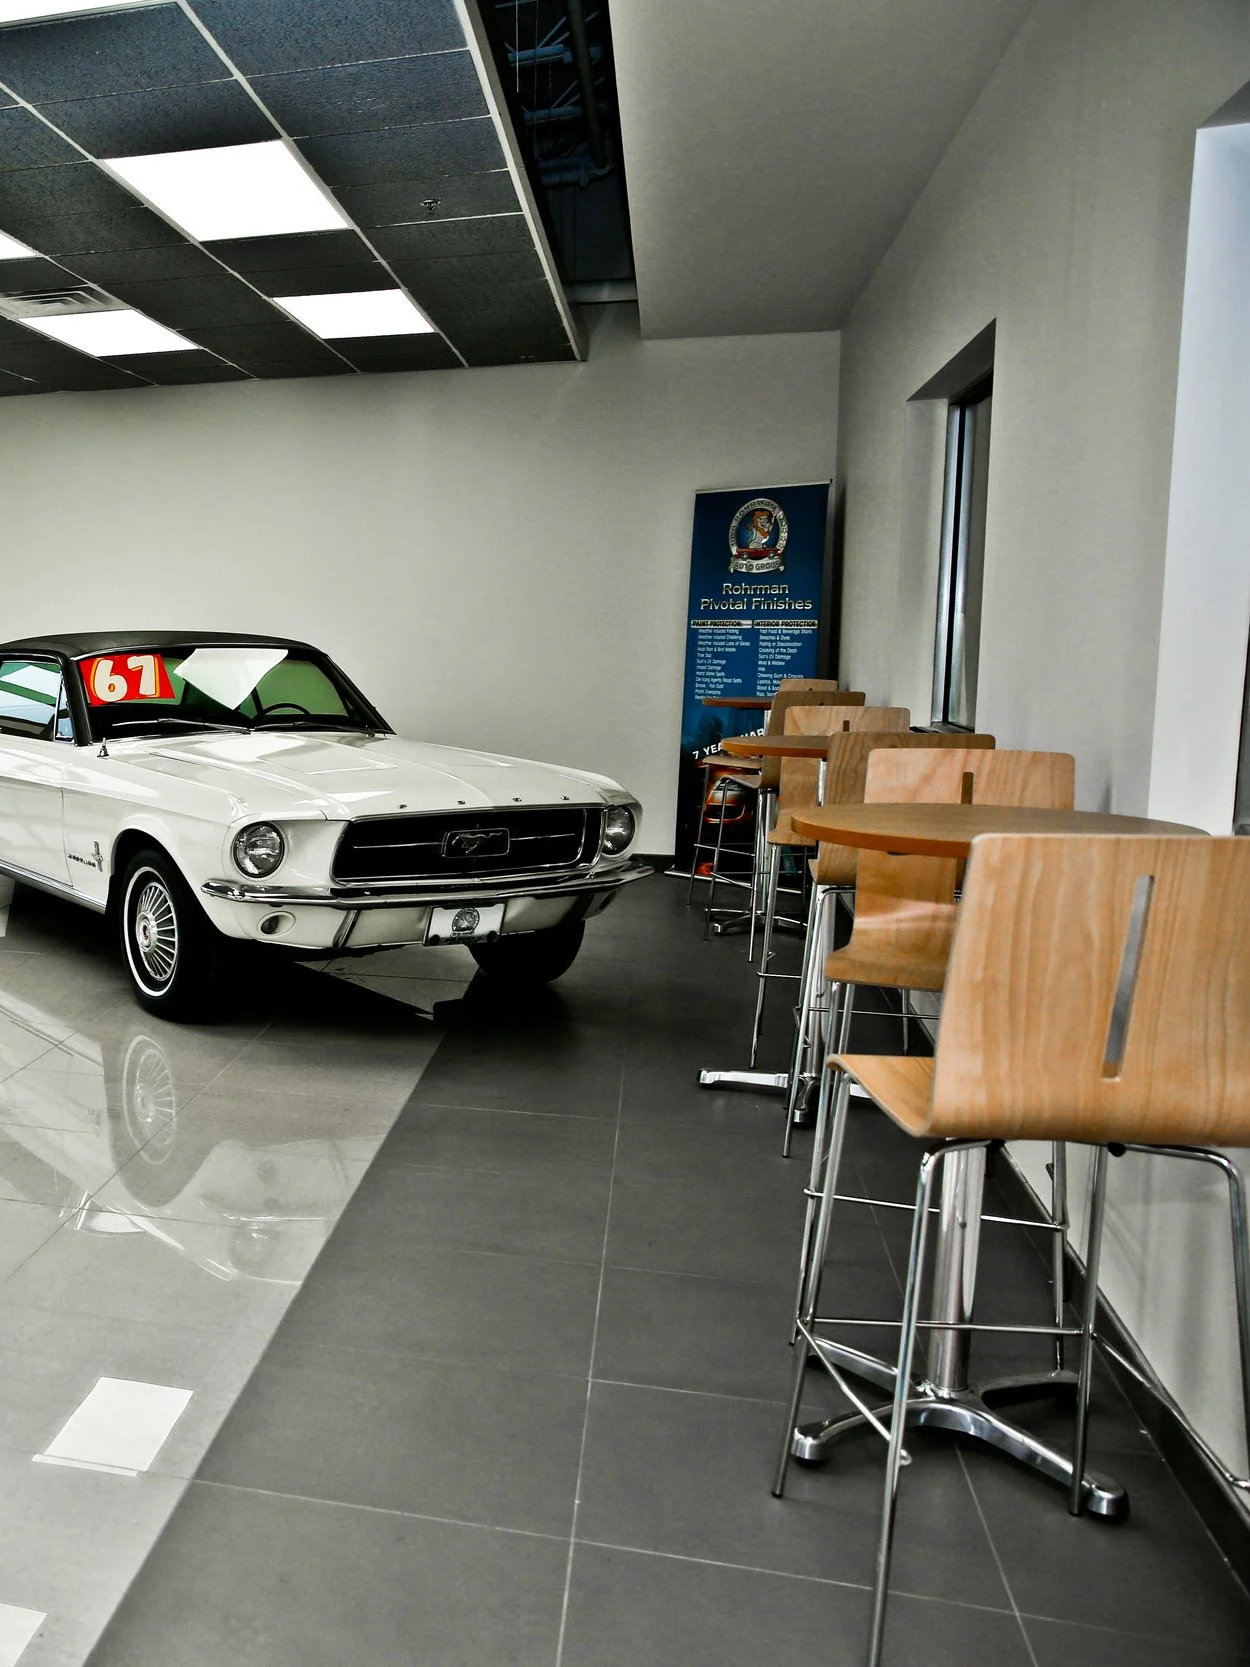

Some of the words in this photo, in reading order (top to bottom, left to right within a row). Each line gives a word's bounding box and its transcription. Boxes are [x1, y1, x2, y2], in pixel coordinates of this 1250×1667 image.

[733, 561, 754, 571] AUTO
[755, 559, 780, 571] GROUP
[722, 583, 789, 595] Rohrman
[700, 598, 747, 610] Pivotal
[751, 597, 813, 610] Finishes
[91, 655, 159, 702] 67
[692, 751, 699, 759] 7
[703, 742, 723, 756] YEA
